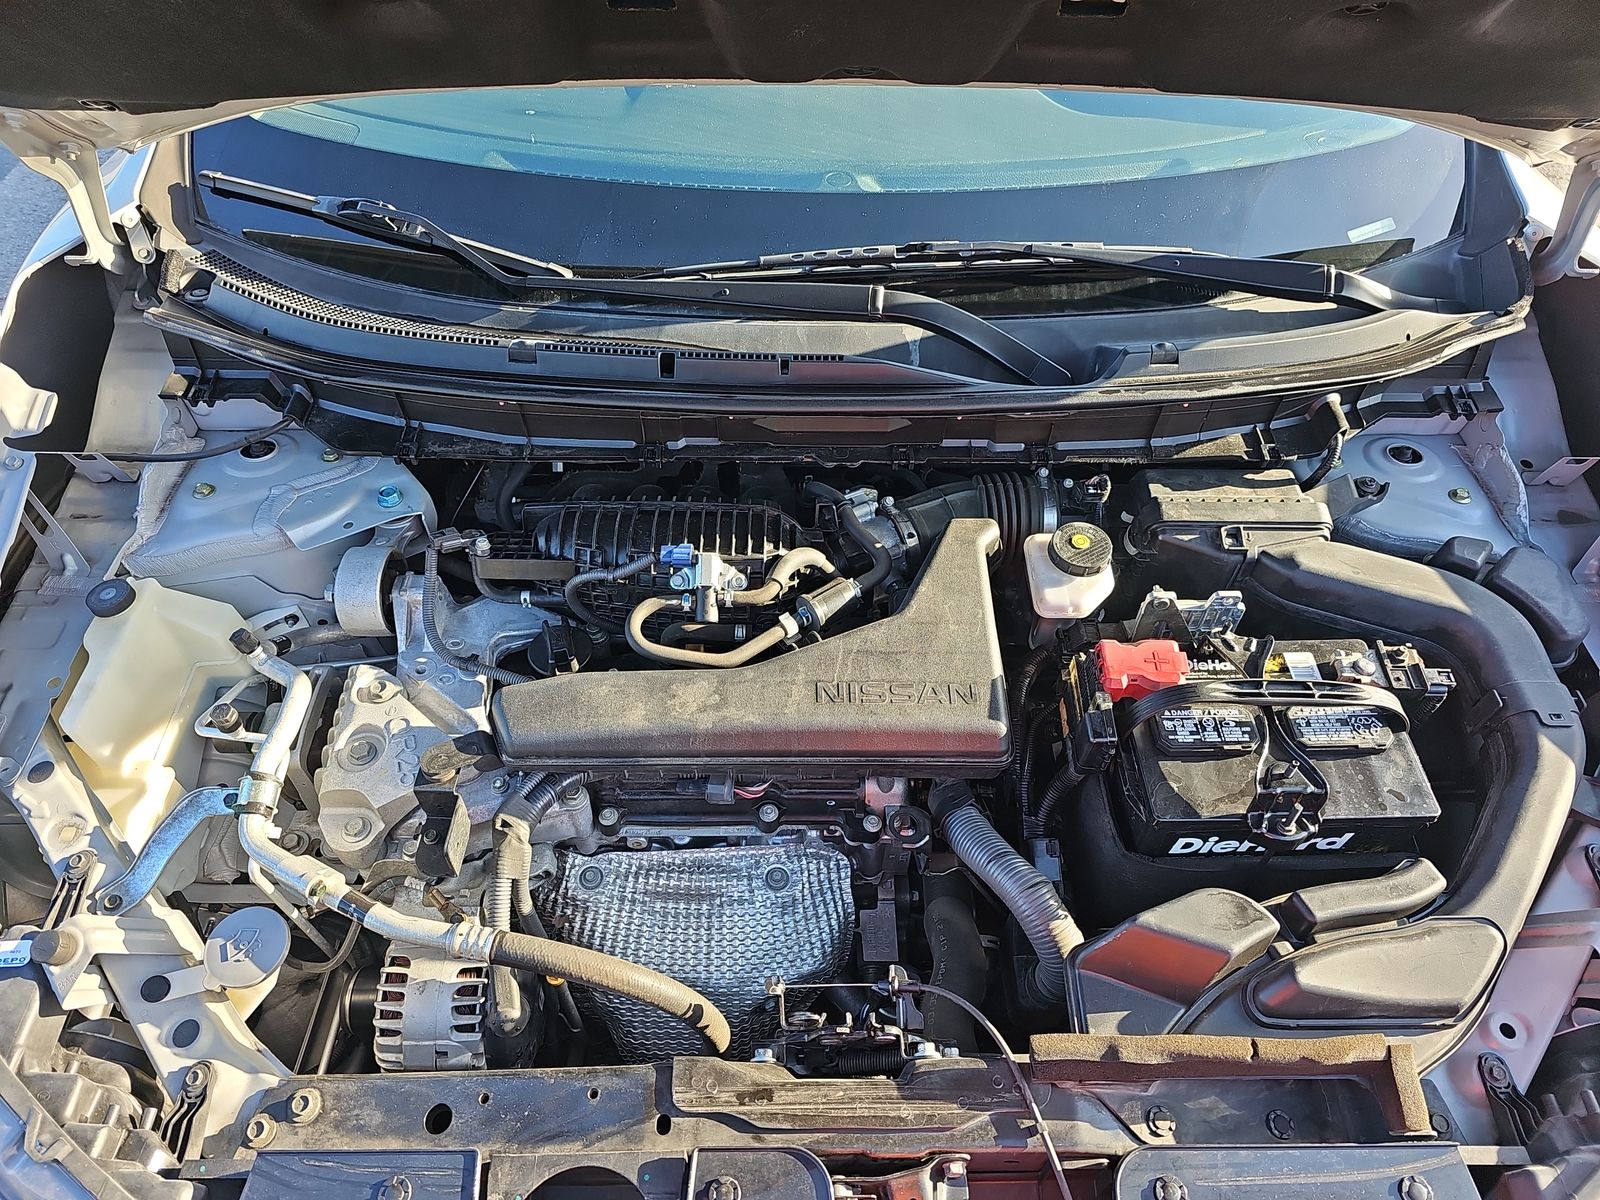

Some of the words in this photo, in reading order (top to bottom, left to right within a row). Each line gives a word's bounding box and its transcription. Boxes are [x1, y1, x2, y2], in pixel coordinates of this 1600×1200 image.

[1187, 658, 1236, 671] ieHa
[815, 681, 980, 705] NISSAN
[1168, 832, 1355, 854] DieHrd
